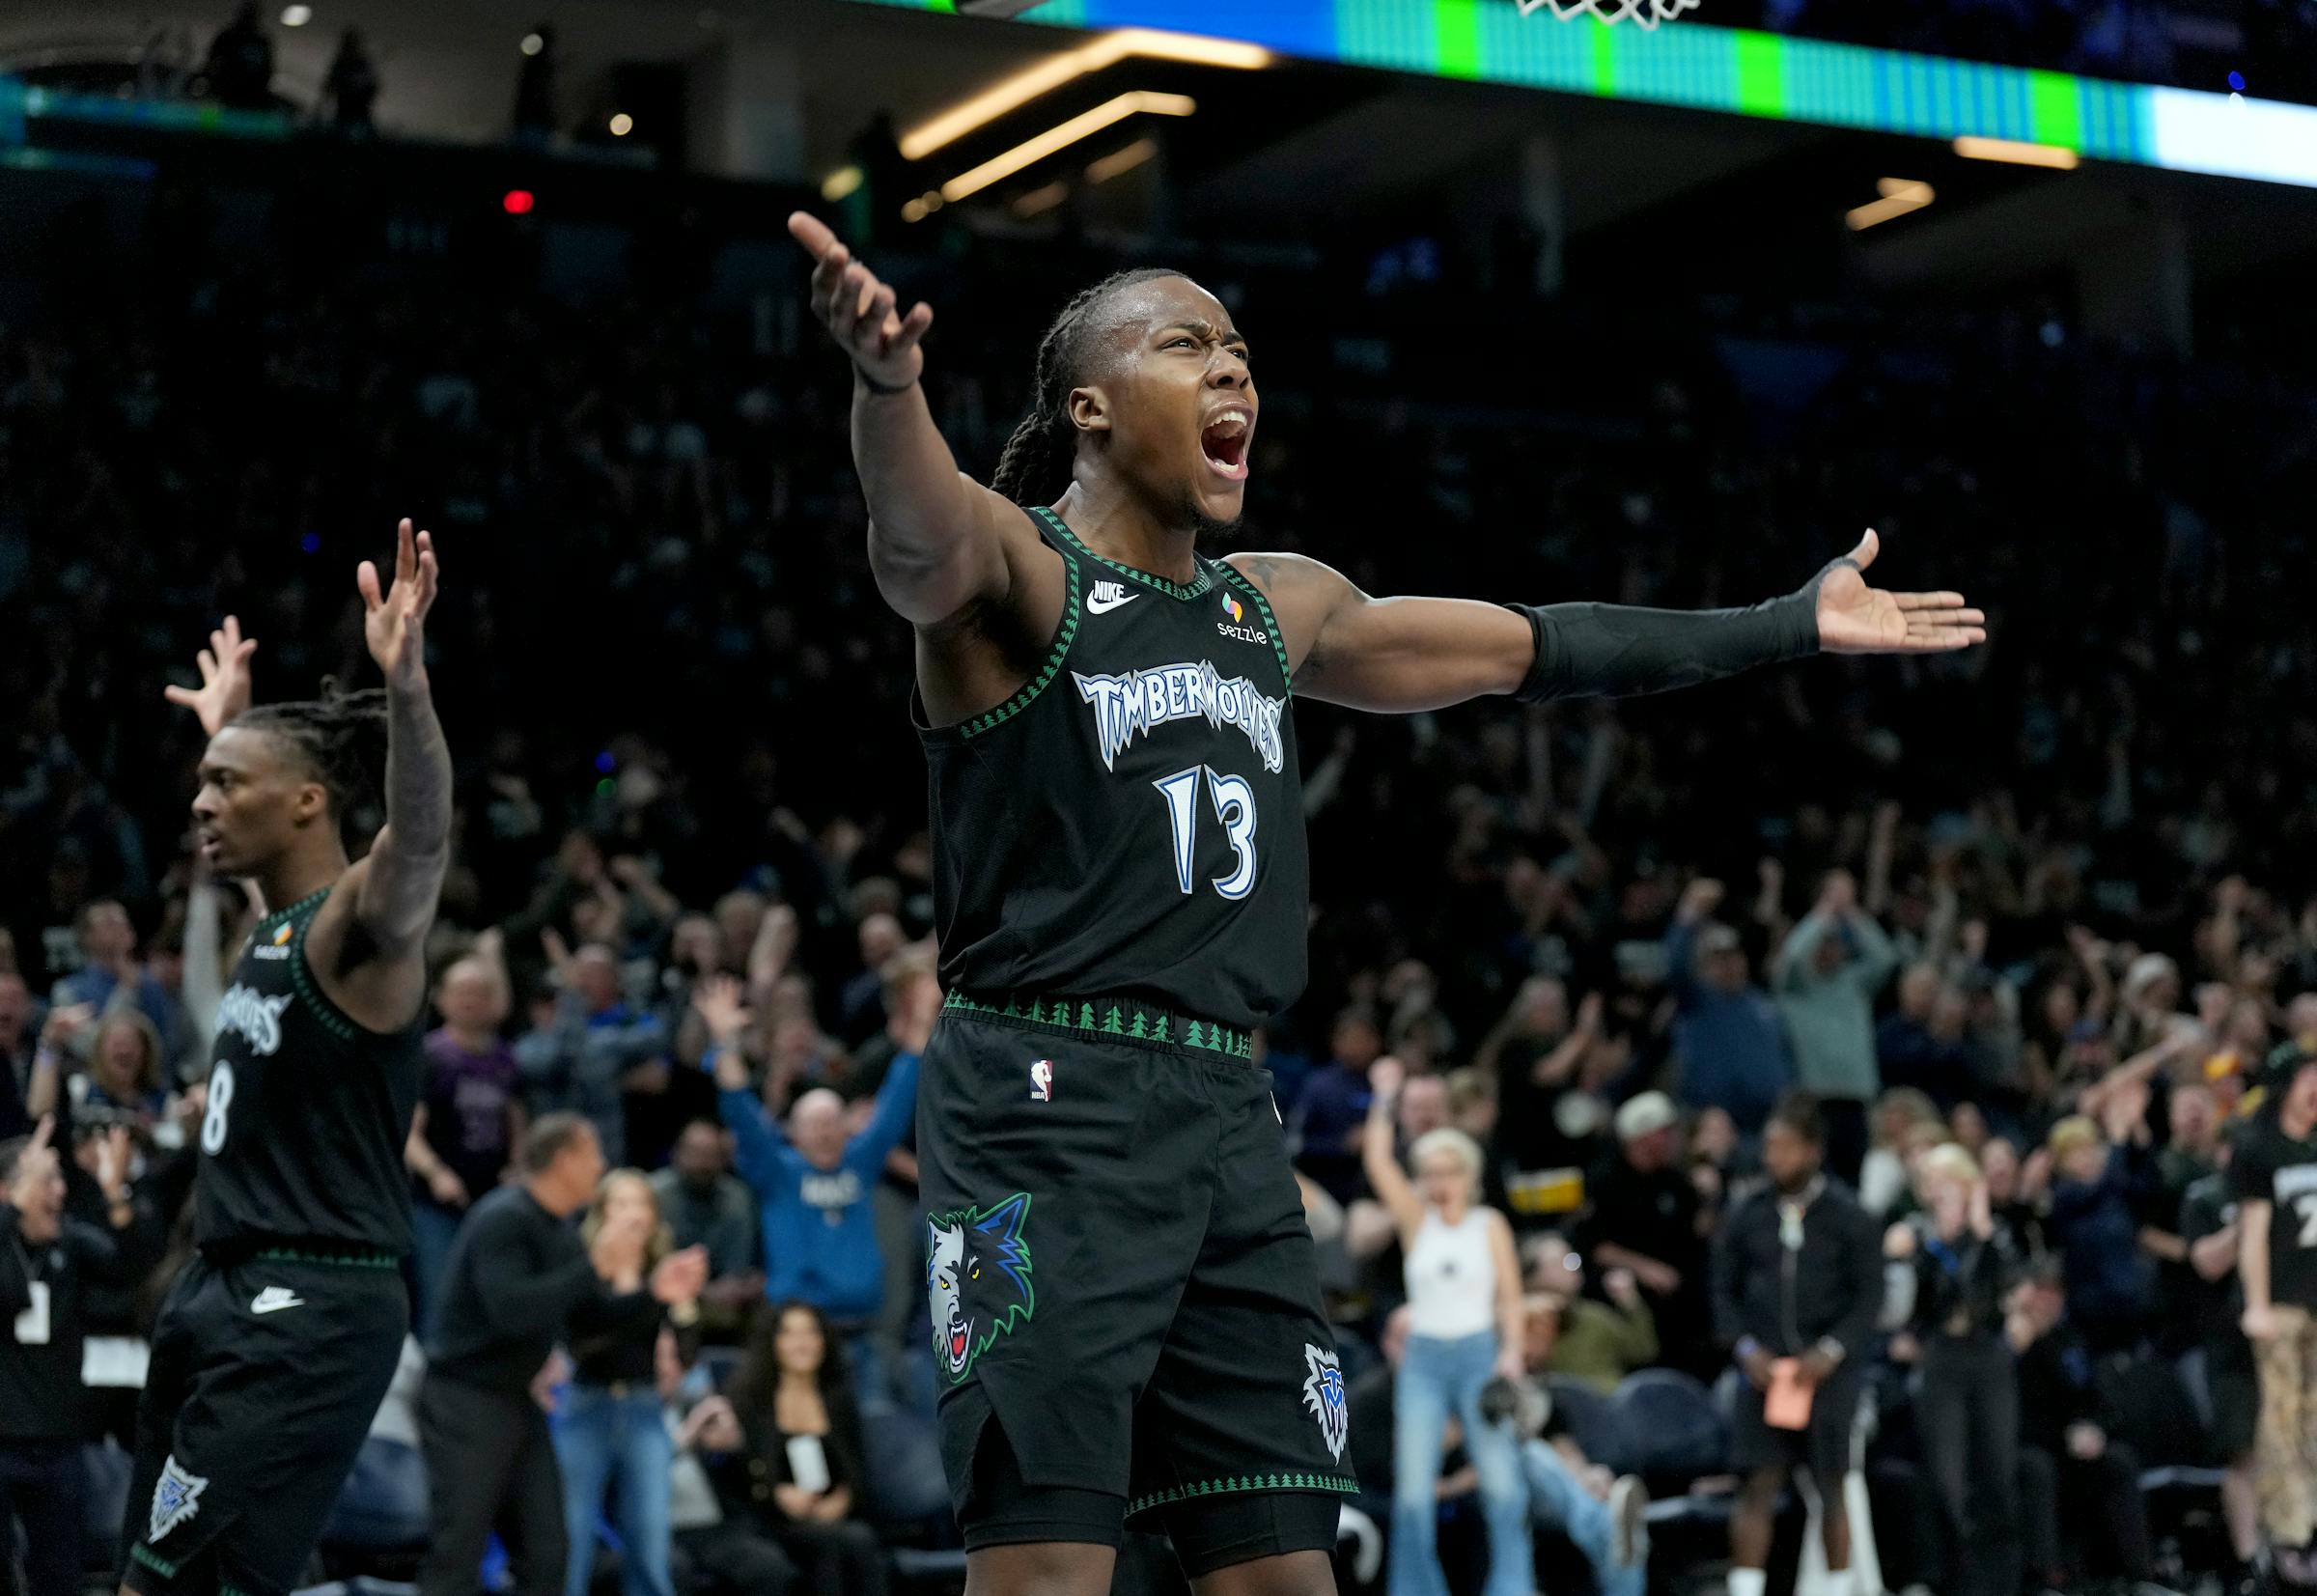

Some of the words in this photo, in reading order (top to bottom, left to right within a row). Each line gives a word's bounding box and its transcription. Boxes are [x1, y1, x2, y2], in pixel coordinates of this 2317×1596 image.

[1094, 580, 1125, 602] NIKE
[1216, 622, 1267, 645] sezzle
[1152, 764, 1257, 900] 13
[1031, 1091, 1046, 1100] NBA
[201, 1059, 235, 1156] 8
